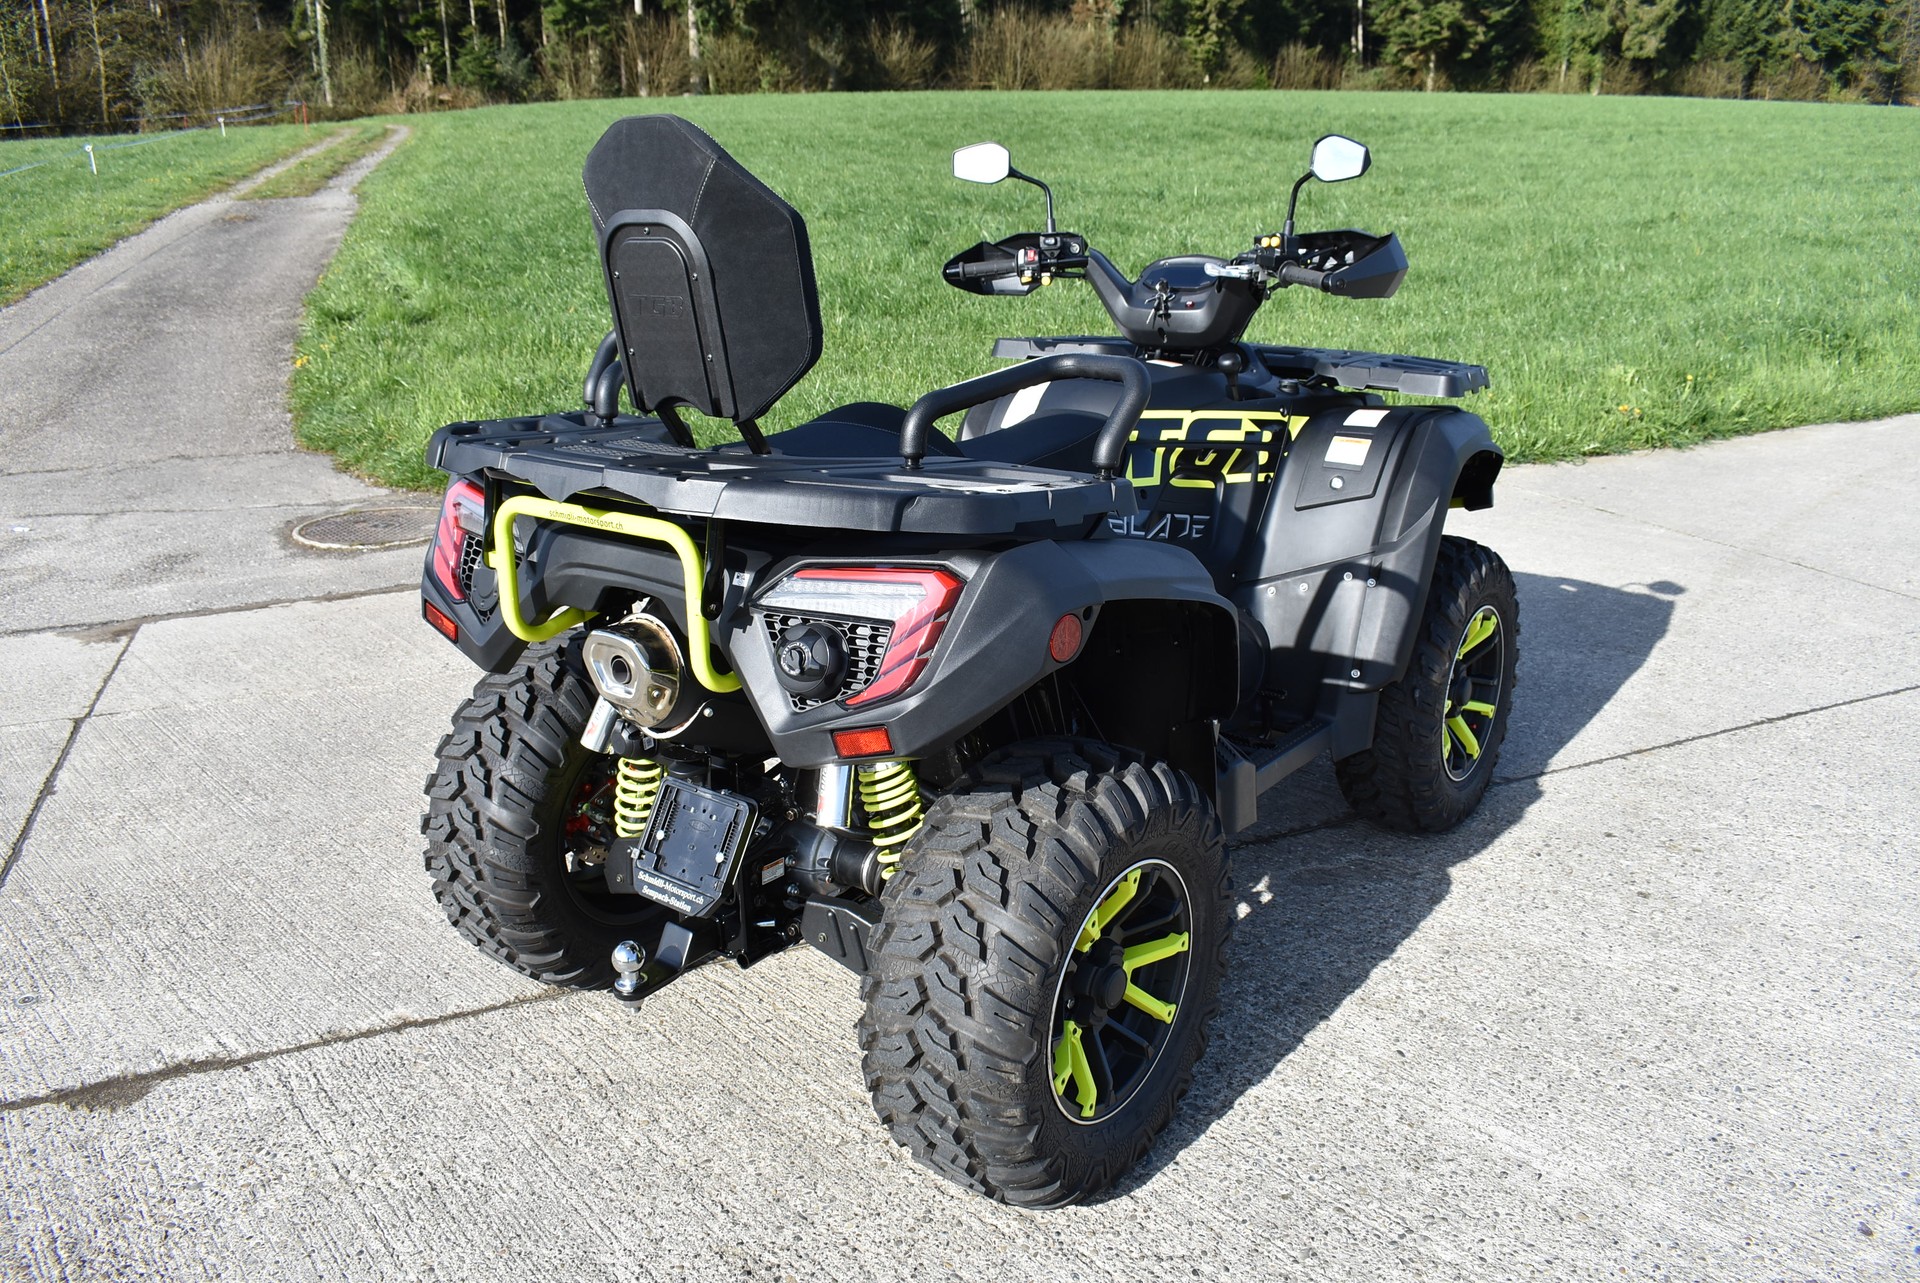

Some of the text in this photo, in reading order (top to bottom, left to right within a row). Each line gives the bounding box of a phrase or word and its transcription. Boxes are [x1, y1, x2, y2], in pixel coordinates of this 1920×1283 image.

[629, 294, 684, 319] TGB
[1108, 513, 1211, 539] BLADE
[637, 871, 704, 905] Schmidli-Motorsport.ch
[642, 885, 692, 912] Sempach-Station
